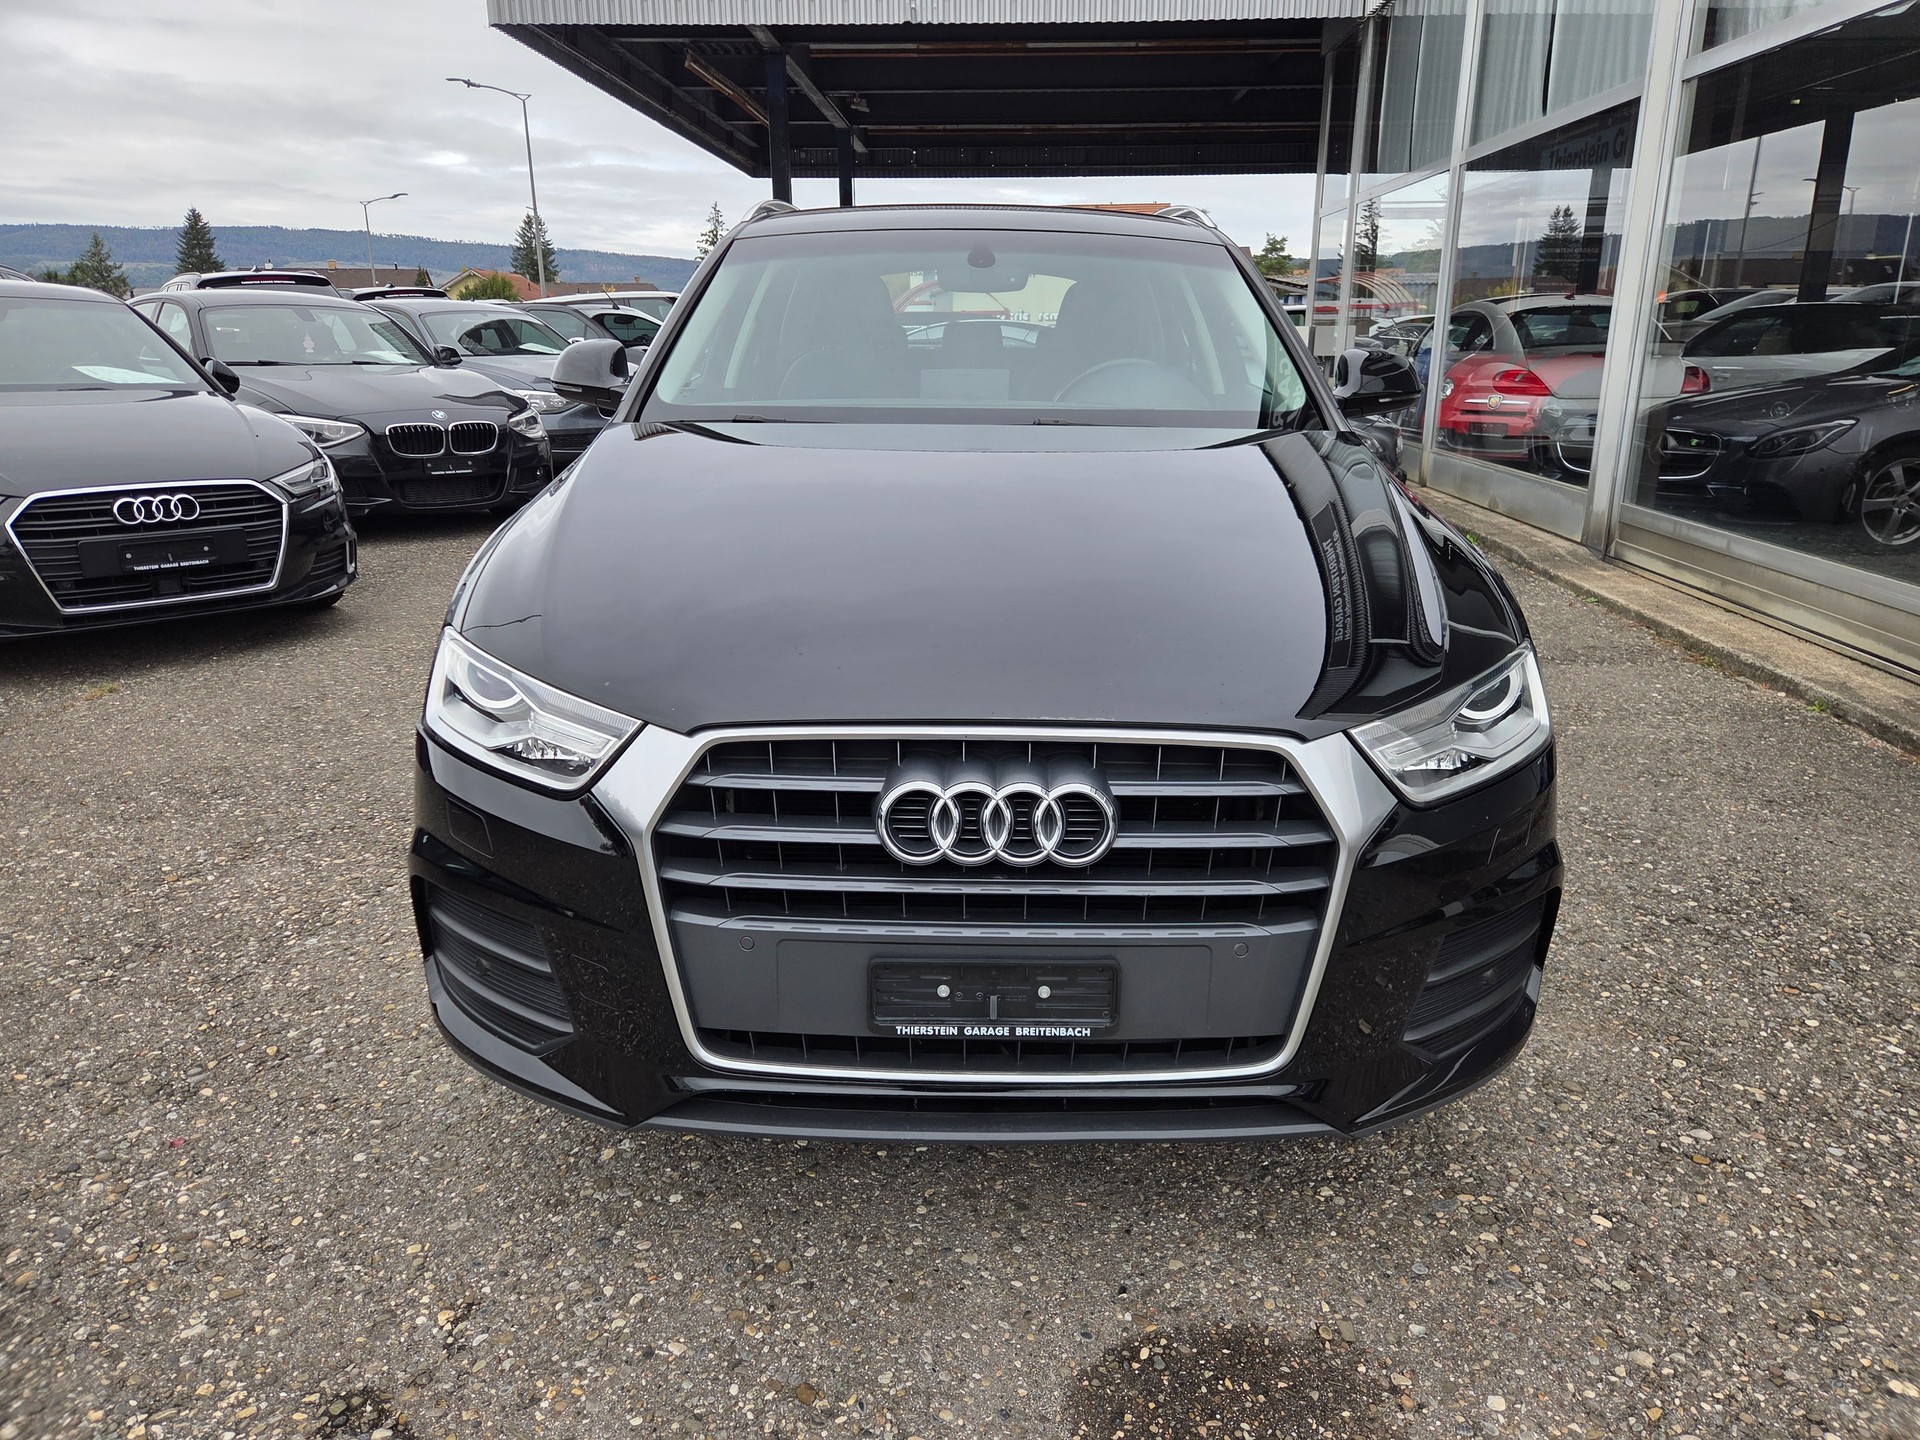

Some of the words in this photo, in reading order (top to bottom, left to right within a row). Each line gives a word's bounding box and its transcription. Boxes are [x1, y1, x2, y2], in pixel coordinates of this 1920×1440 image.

[895, 1026, 958, 1036] THIERSTEIN
[963, 1026, 1010, 1036] GARAGE
[1015, 1026, 1091, 1037] BREITENBACH
